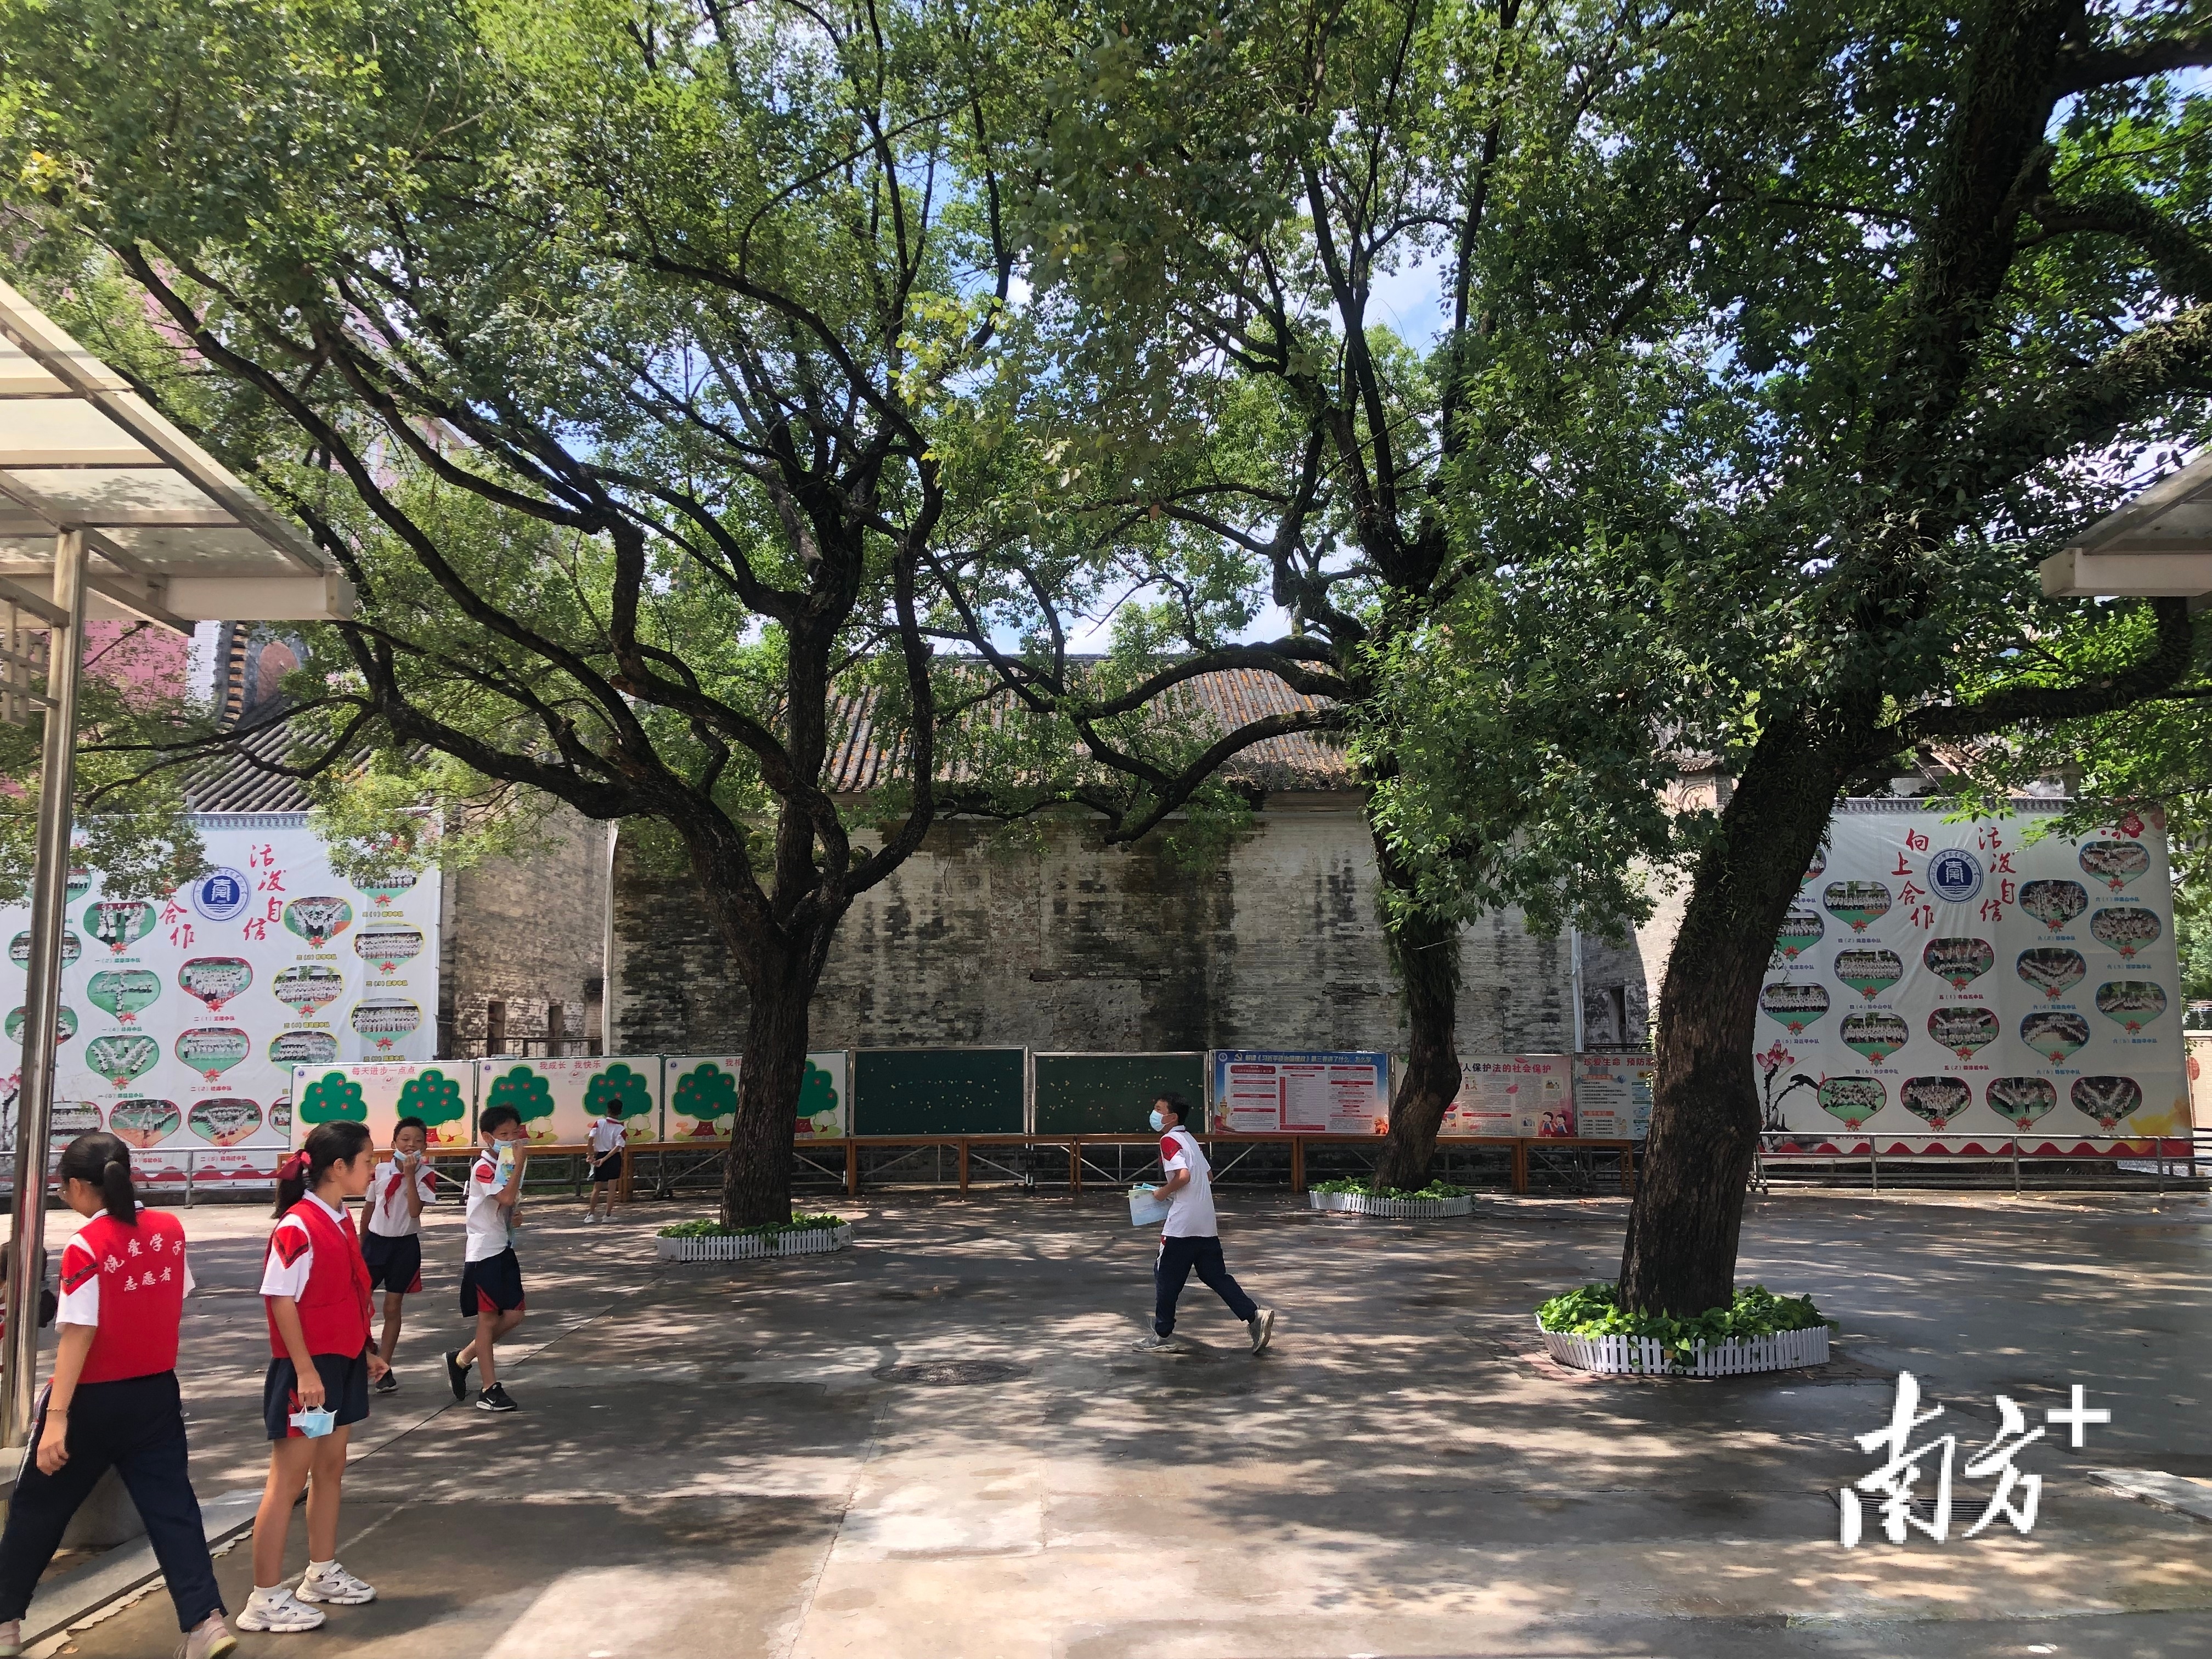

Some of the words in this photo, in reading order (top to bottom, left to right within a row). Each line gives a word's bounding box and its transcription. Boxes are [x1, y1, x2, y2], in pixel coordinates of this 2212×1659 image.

[1891, 828, 1934, 929] 向上合作
[539, 1061, 566, 1070] 我成长
[574, 1060, 601, 1069] 我快乐
[1583, 1057, 1622, 1067] 珍爱生命
[352, 1065, 415, 1076] 每天进步一点点
[1462, 1062, 1552, 1074] 人保护法的社会保护
[124, 1266, 172, 1291] 志愿者
